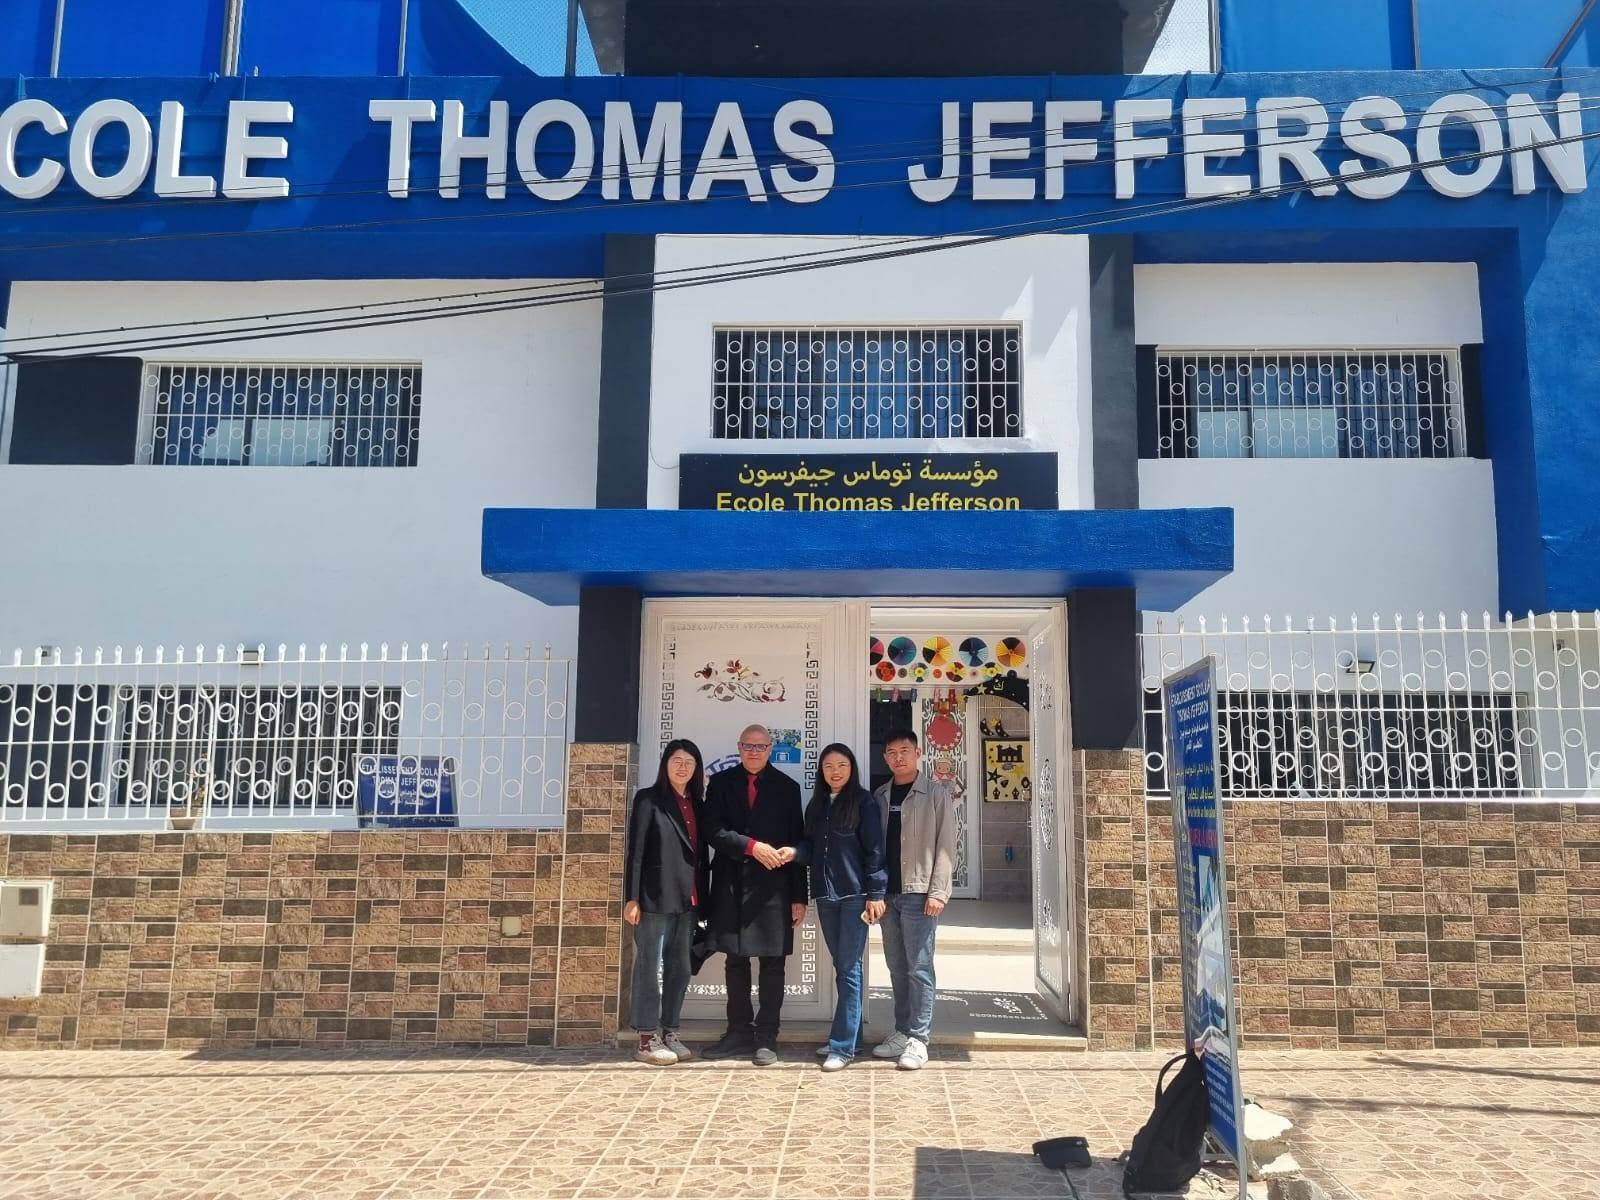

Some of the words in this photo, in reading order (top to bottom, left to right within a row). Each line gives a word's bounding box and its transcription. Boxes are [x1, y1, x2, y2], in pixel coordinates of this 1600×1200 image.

[368, 98, 835, 203] THOMAS
[907, 92, 1588, 203] JEFFERSON
[737, 460, 836, 489] جيفرسون
[842, 460, 912, 488] توماس
[919, 459, 999, 486] مؤسسة
[715, 492, 785, 511] Ecole
[793, 492, 893, 511] Thomas
[901, 492, 1021, 511] Jefferson
